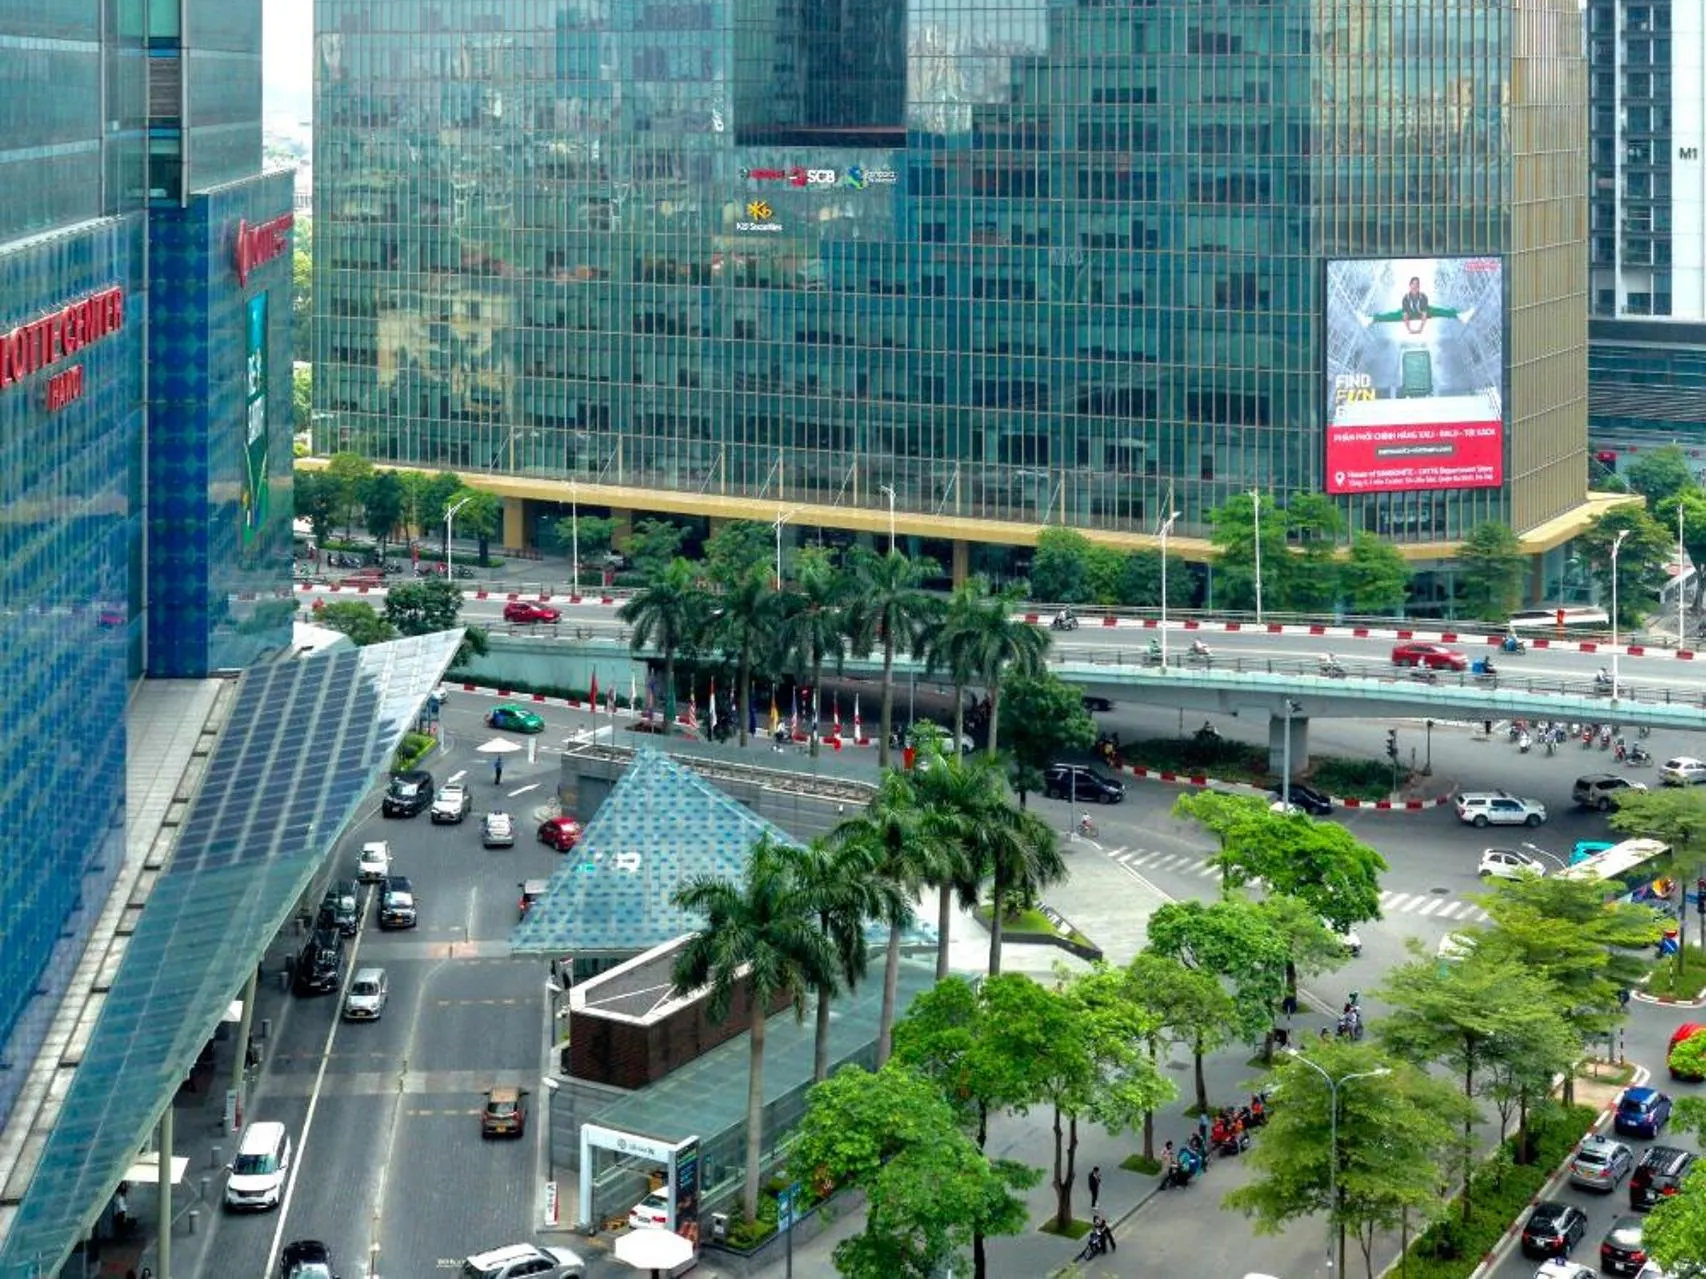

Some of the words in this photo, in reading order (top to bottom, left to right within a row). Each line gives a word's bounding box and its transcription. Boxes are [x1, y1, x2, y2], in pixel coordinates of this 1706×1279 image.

[1679, 147, 1697, 160] M1
[807, 169, 835, 183] SCB
[0, 309, 62, 391] LOTTE
[61, 286, 124, 356] CENTER
[1335, 373, 1371, 389] FIND
